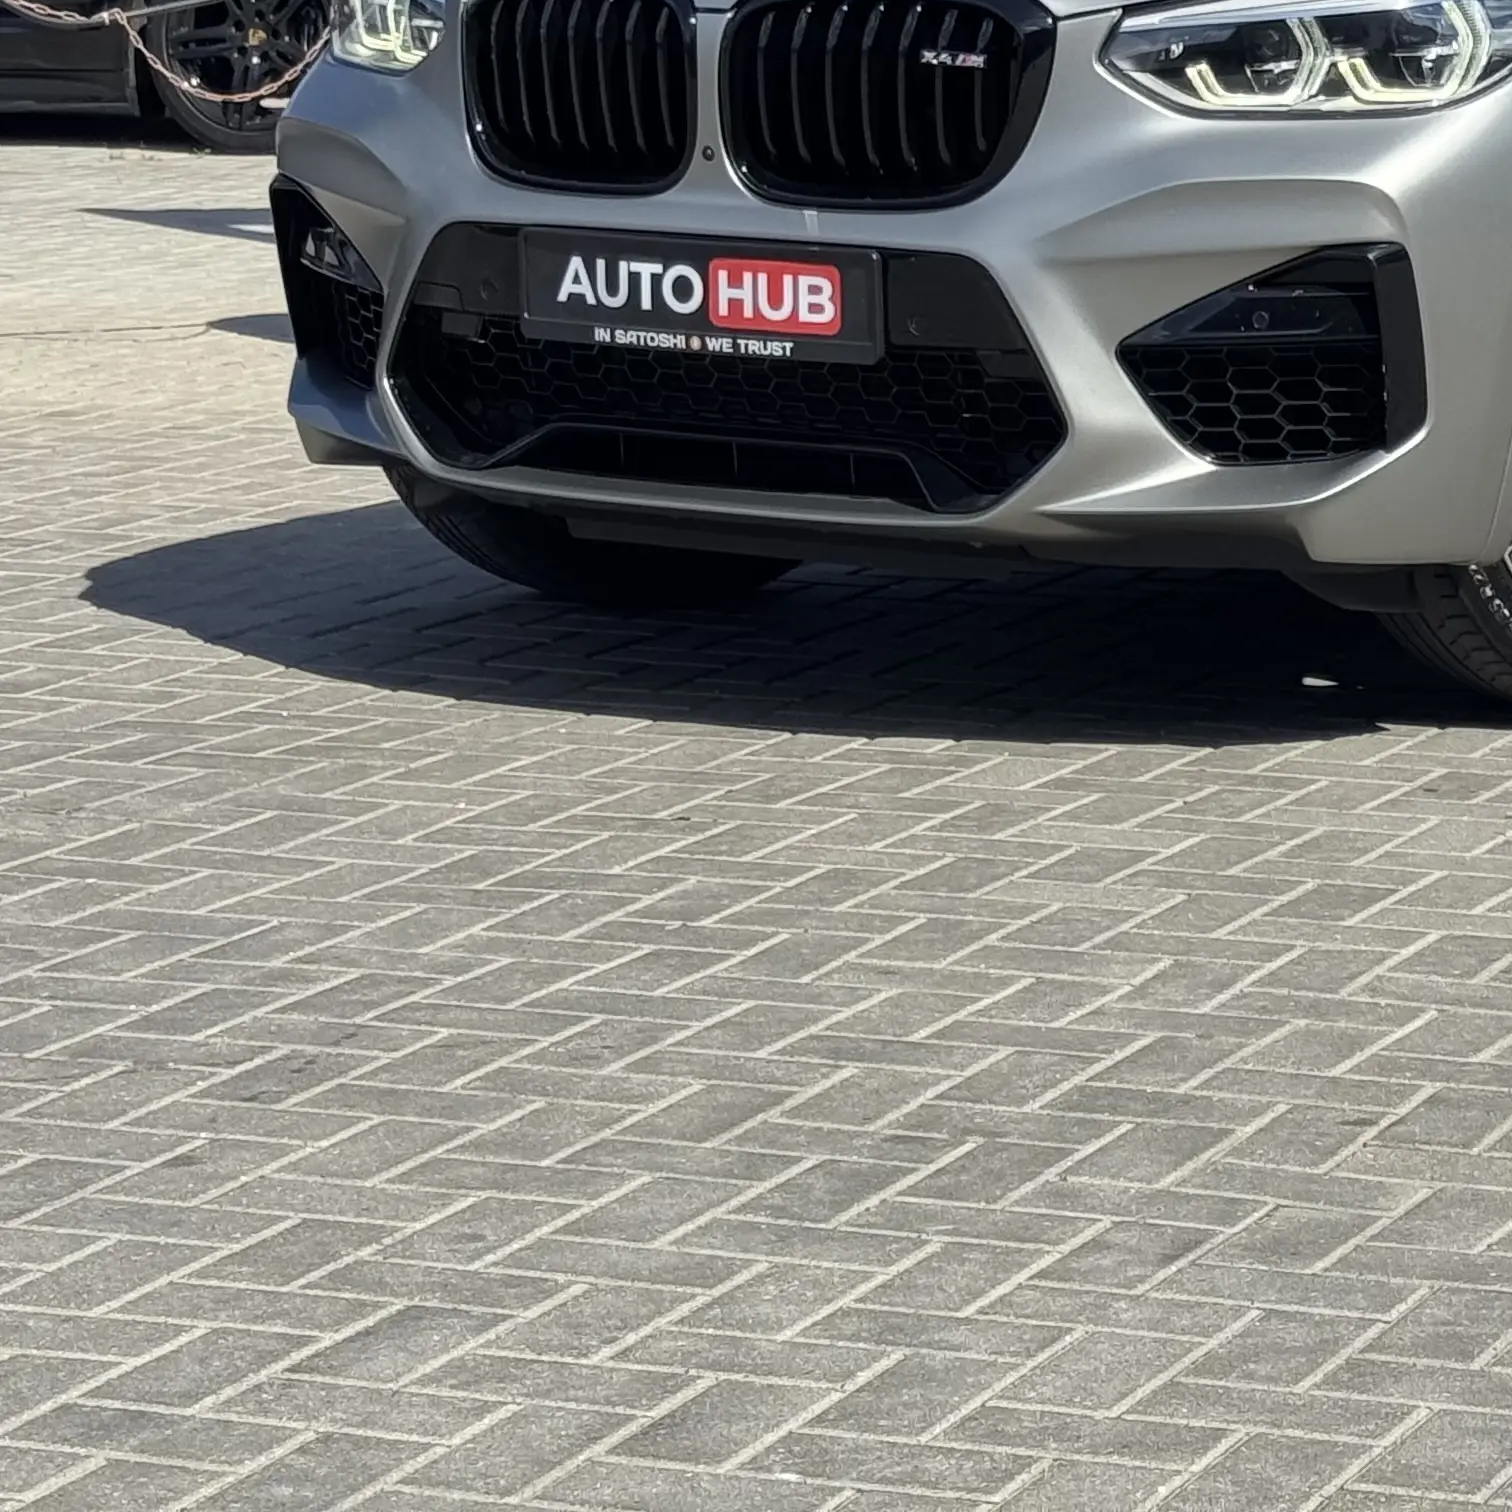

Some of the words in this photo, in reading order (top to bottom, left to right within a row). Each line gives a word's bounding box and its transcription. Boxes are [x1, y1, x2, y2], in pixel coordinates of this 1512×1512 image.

[556, 255, 704, 315] AUTO
[717, 269, 836, 324] HUB
[594, 327, 611, 342] IN
[614, 329, 686, 349] SATOSHI
[704, 336, 733, 352] WE
[735, 339, 794, 357] TRUST
